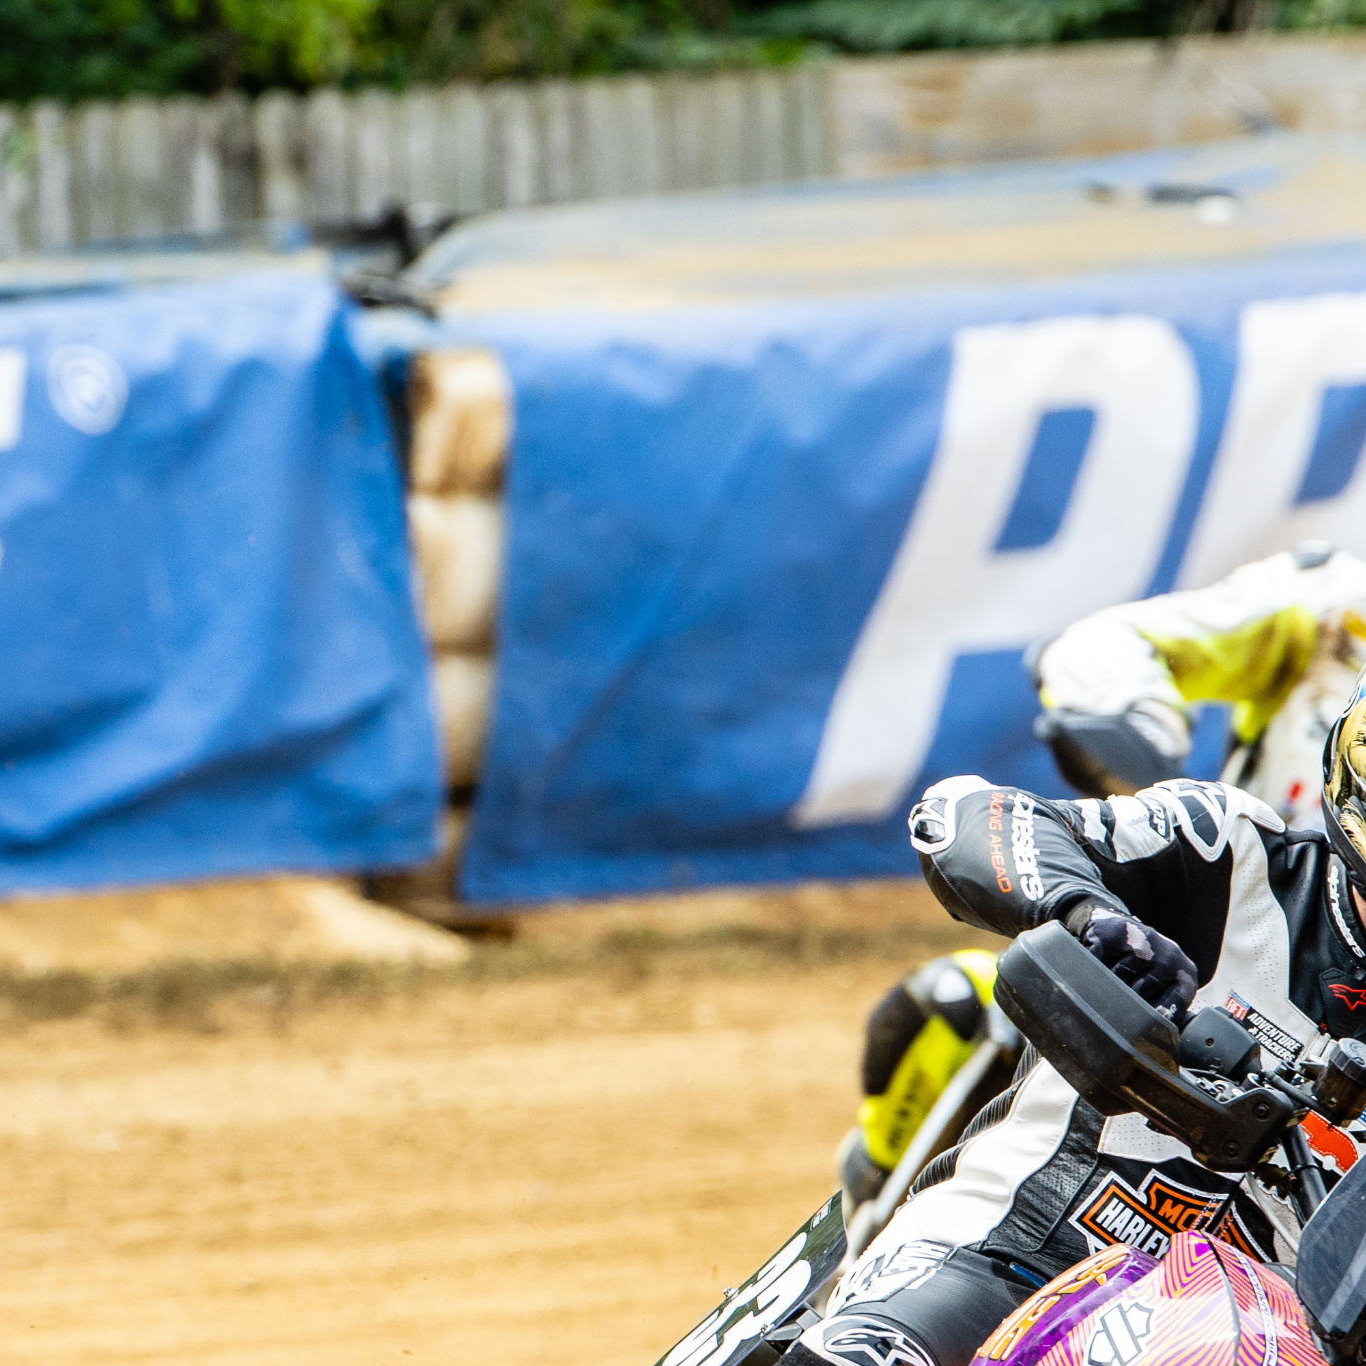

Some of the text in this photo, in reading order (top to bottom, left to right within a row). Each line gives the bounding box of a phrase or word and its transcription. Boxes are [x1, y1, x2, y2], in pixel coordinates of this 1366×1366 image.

[988, 791, 1013, 893] RACING AHEAD
[1248, 1012, 1303, 1052] ADVENTURE
[1096, 1197, 1171, 1260] HARLEY
